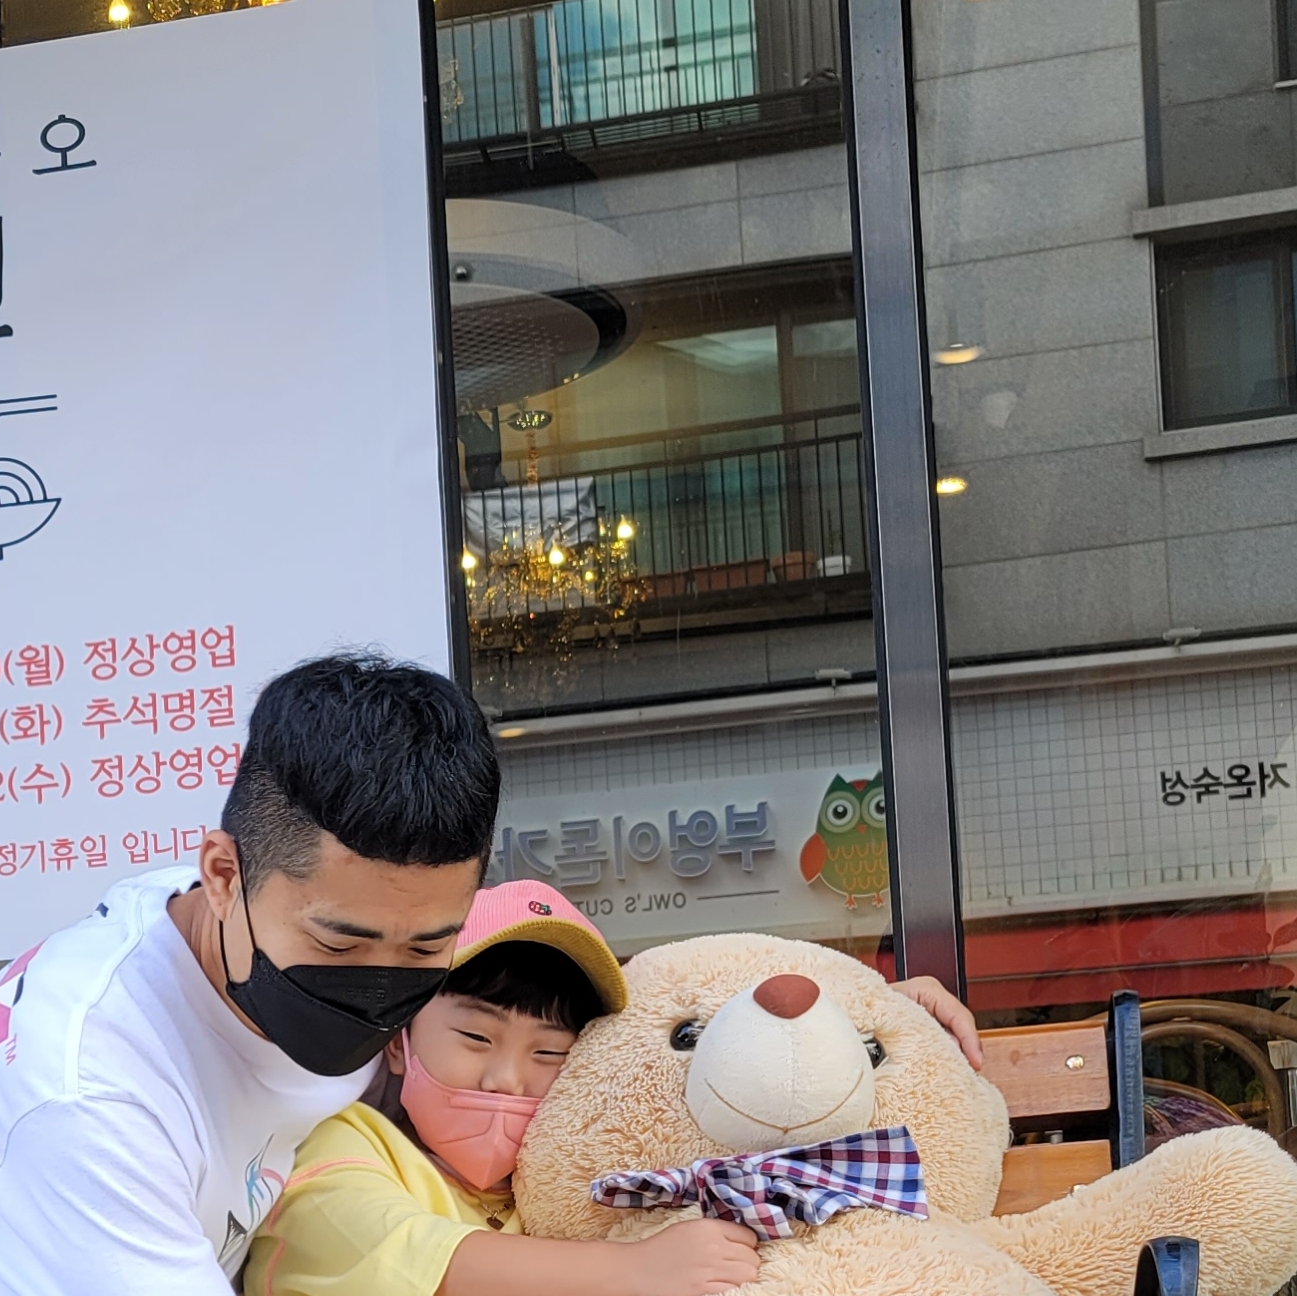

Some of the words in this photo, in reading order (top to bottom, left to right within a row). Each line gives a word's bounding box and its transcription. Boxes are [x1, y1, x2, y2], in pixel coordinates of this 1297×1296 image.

[31, 113, 99, 177] 오
[83, 624, 238, 682] 정상영업
[82, 683, 236, 740] 추석명절
[89, 742, 242, 799] 정상영업
[121, 826, 207, 865] 입니다
